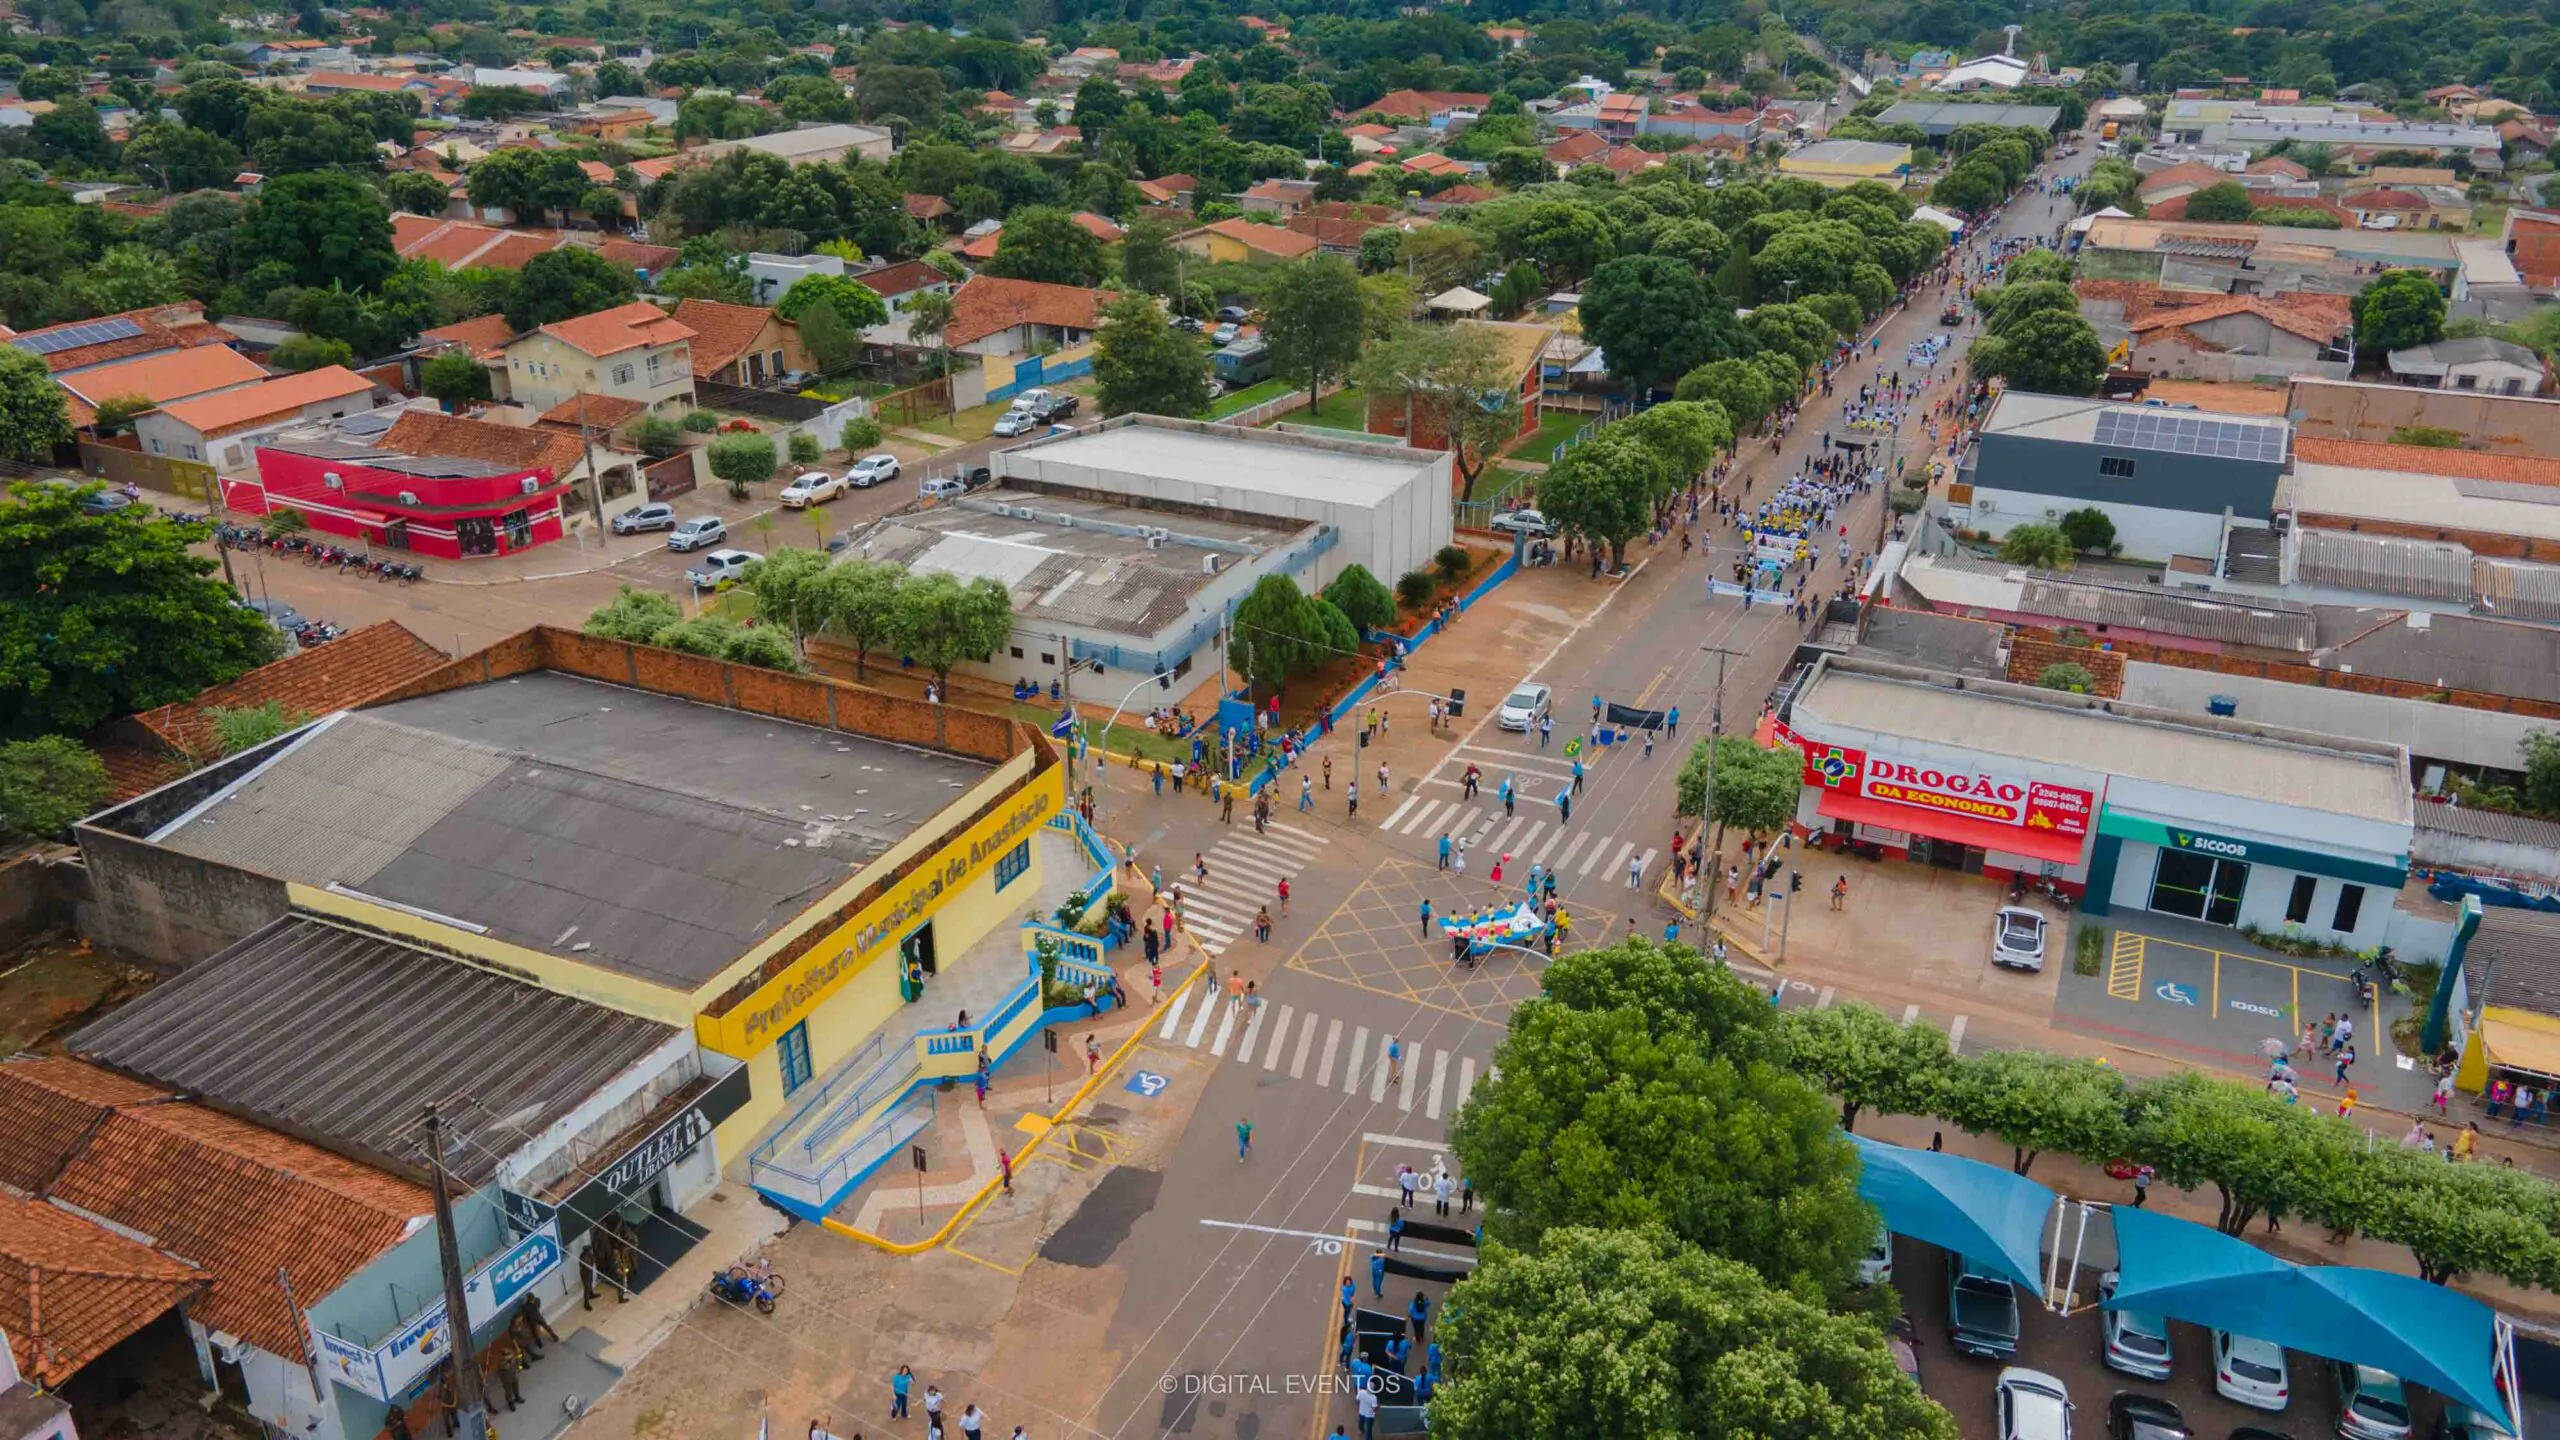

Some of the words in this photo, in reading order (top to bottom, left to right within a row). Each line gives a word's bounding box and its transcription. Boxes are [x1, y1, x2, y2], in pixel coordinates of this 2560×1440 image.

[1869, 759, 2024, 802] DROGÃO
[1875, 784, 1902, 799] DA
[1906, 789, 2010, 819] ECONOMIA
[2194, 836, 2247, 857] SICOOB
[743, 945, 855, 1046] Prefeitura
[855, 868, 945, 958] Municipal
[945, 857, 968, 886] de
[970, 793, 1050, 870] Anastácio
[2230, 1000, 2280, 1018] IDOSO
[607, 1121, 681, 1194] OUTLET
[495, 1245, 540, 1284] CAIXA
[511, 1245, 549, 1284] aqui
[1311, 1239, 1343, 1256] 10
